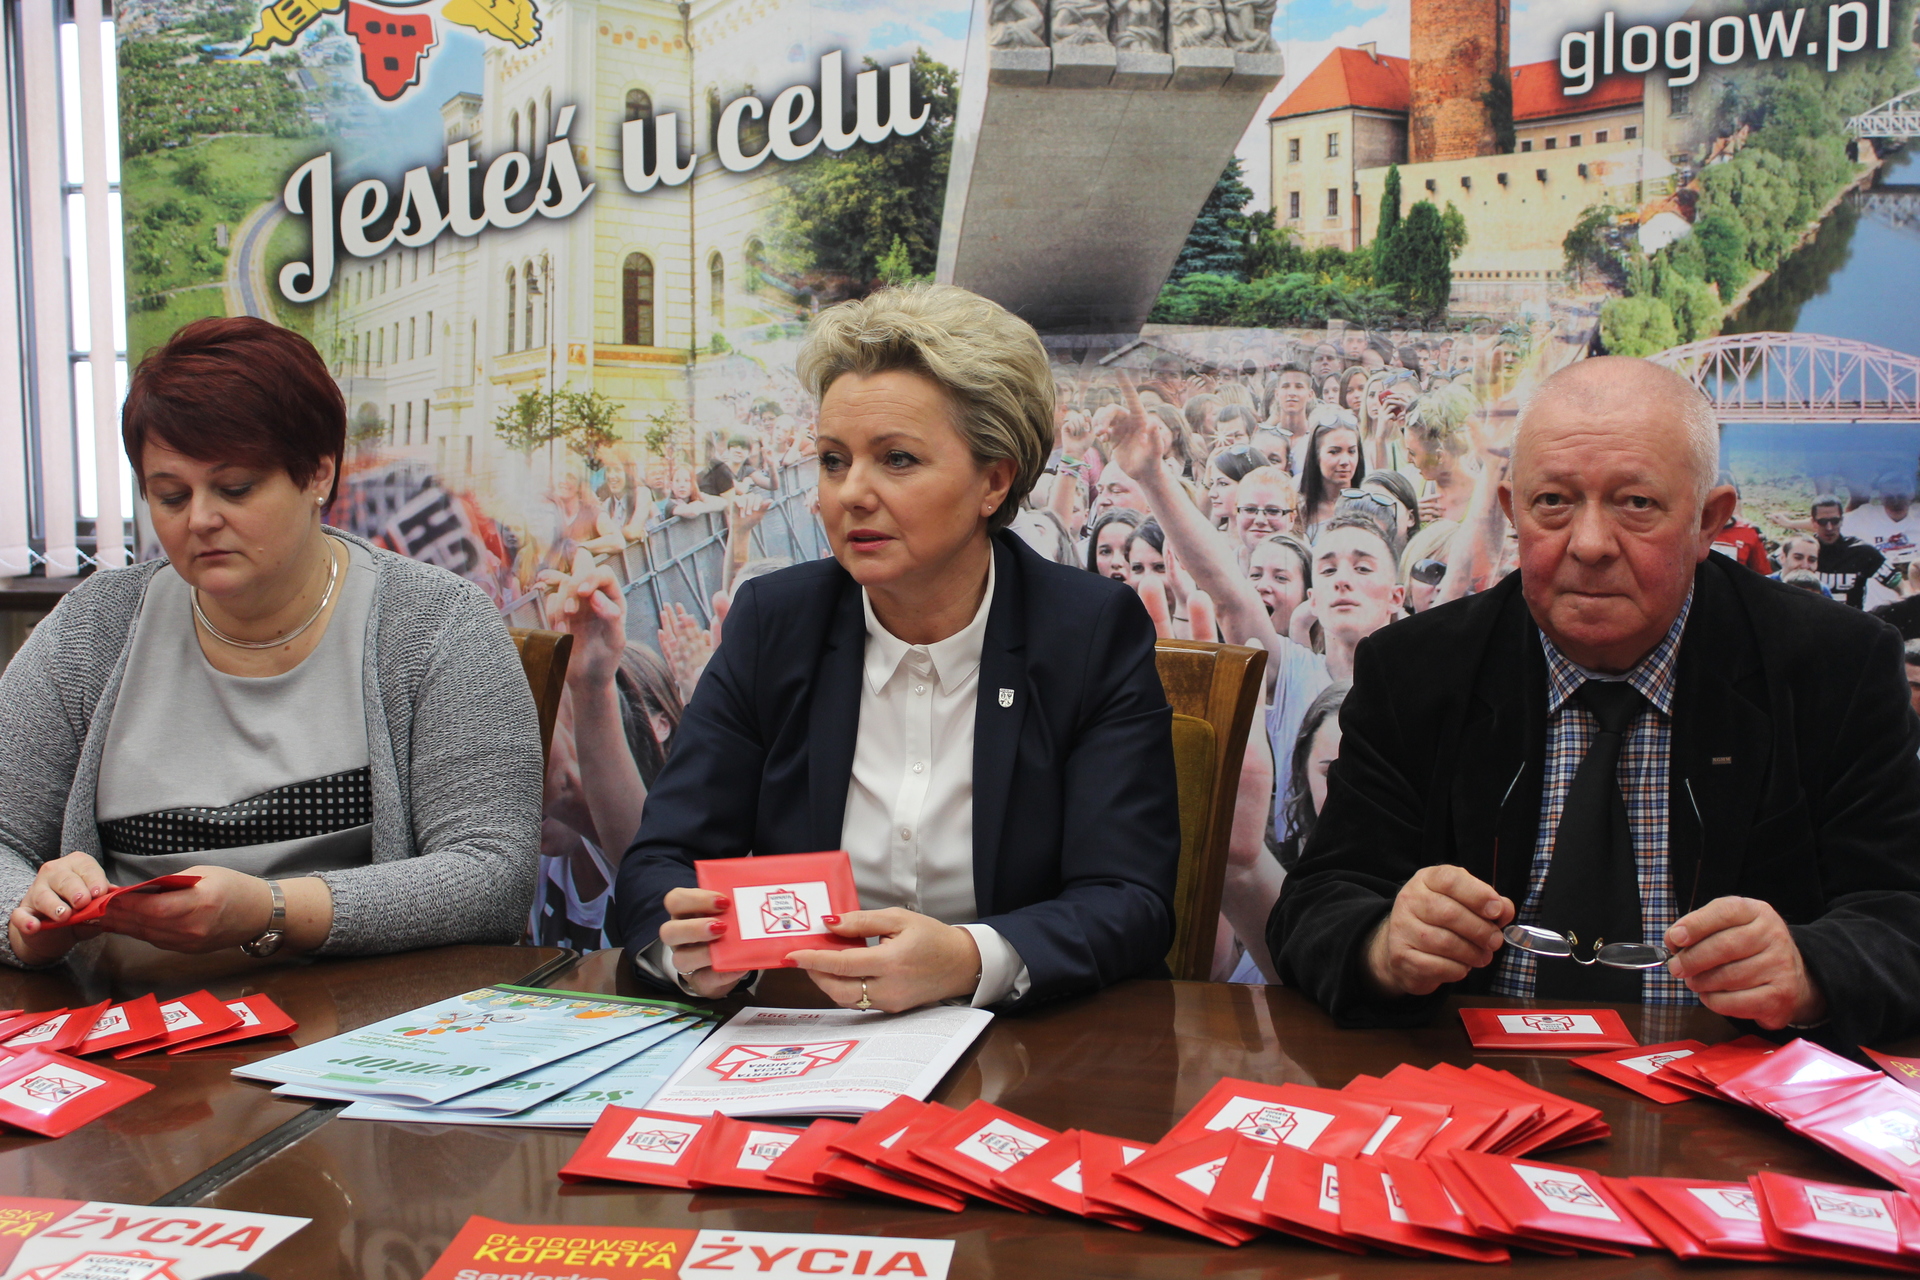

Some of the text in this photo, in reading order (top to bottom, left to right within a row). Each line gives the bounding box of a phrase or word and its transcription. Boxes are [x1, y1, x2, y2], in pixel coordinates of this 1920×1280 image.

[1559, 0, 1890, 96] glogow.pl
[278, 49, 931, 302] Jesteś u celu
[326, 1055, 491, 1077] senior
[737, 1070, 797, 1078] KOPERTA
[748, 1060, 807, 1068] SENIORA
[0, 1208, 55, 1223] SKA
[41, 1208, 265, 1252] ŻYCIA
[486, 1233, 678, 1253] GŁOGOWSKA
[85, 1256, 155, 1268] KOPERTA
[473, 1244, 672, 1269] KOPERTA
[688, 1236, 928, 1278] ŻYCIA
[84, 1263, 130, 1275] ŻYCIA
